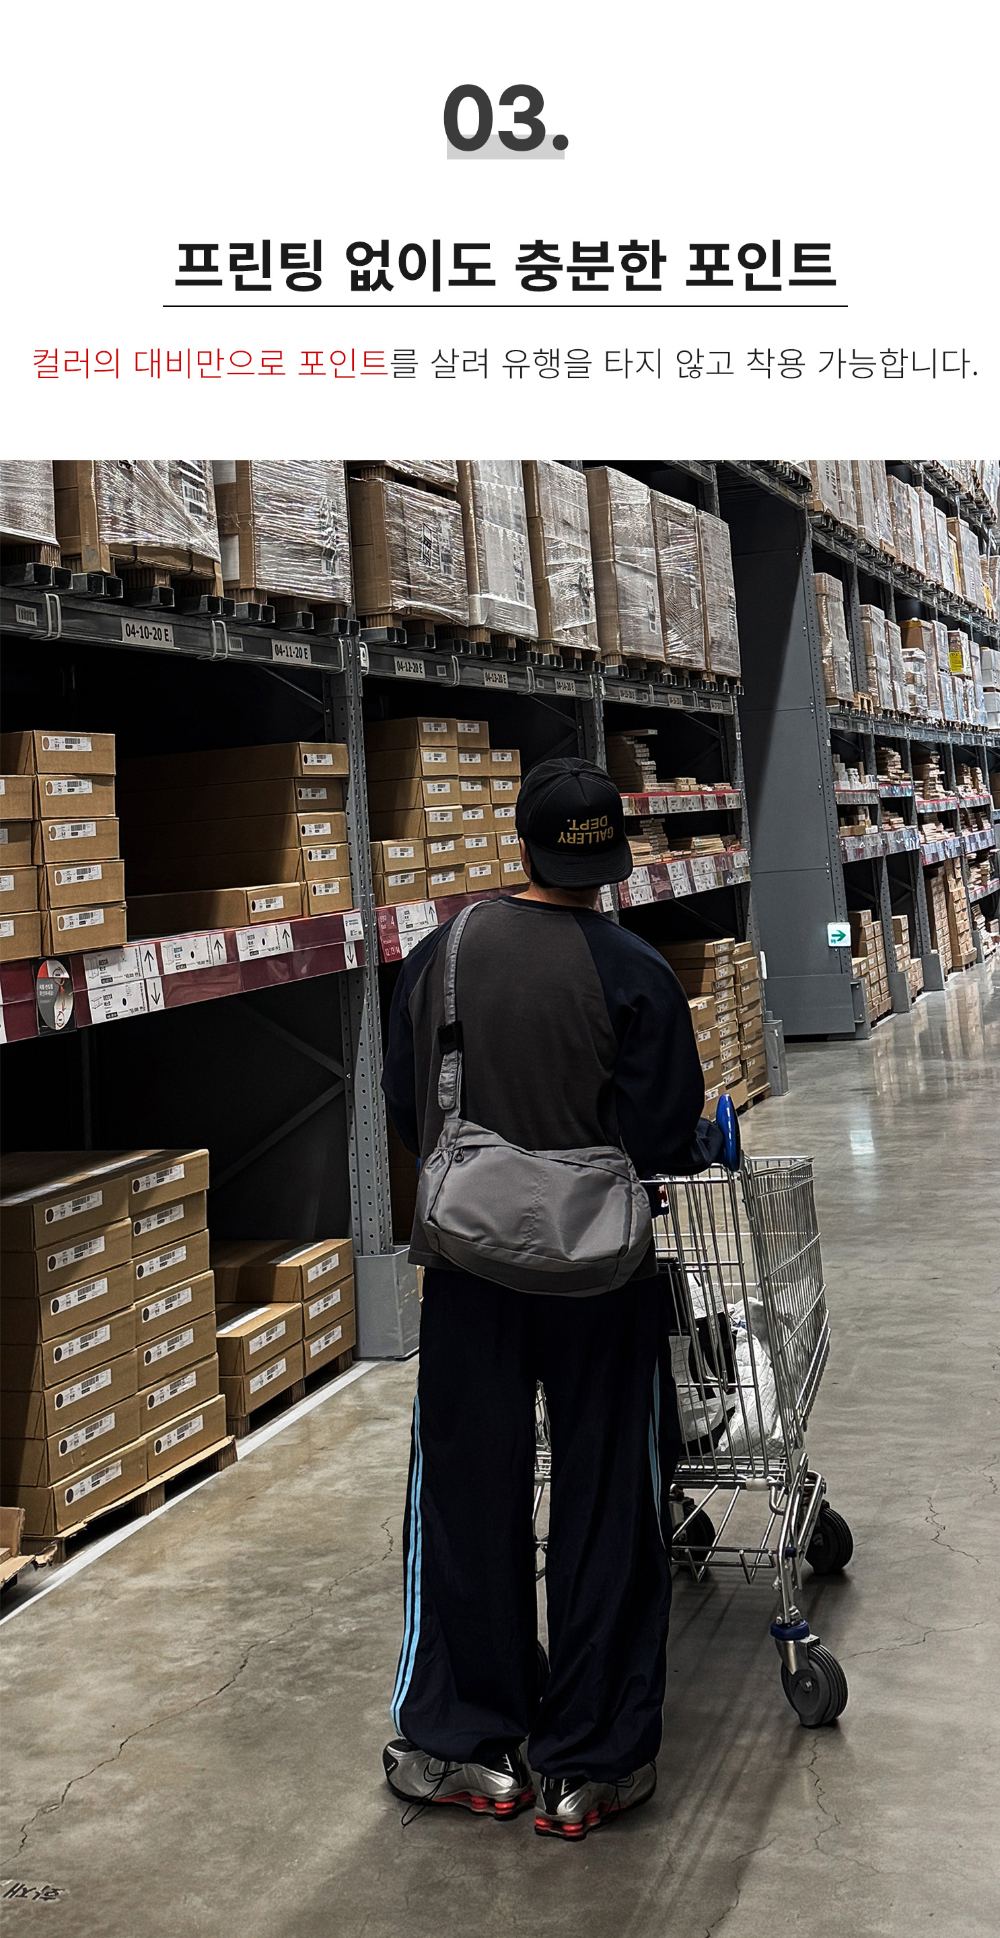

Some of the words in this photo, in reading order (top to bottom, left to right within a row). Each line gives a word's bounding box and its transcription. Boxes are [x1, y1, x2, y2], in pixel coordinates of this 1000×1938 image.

[125, 623, 163, 641] 04-10-20
[274, 643, 303, 659] 04-11-20
[303, 648, 309, 660] E
[419, 662, 424, 674] E
[566, 814, 608, 831] DEPT.
[557, 826, 614, 845] GALLERY
